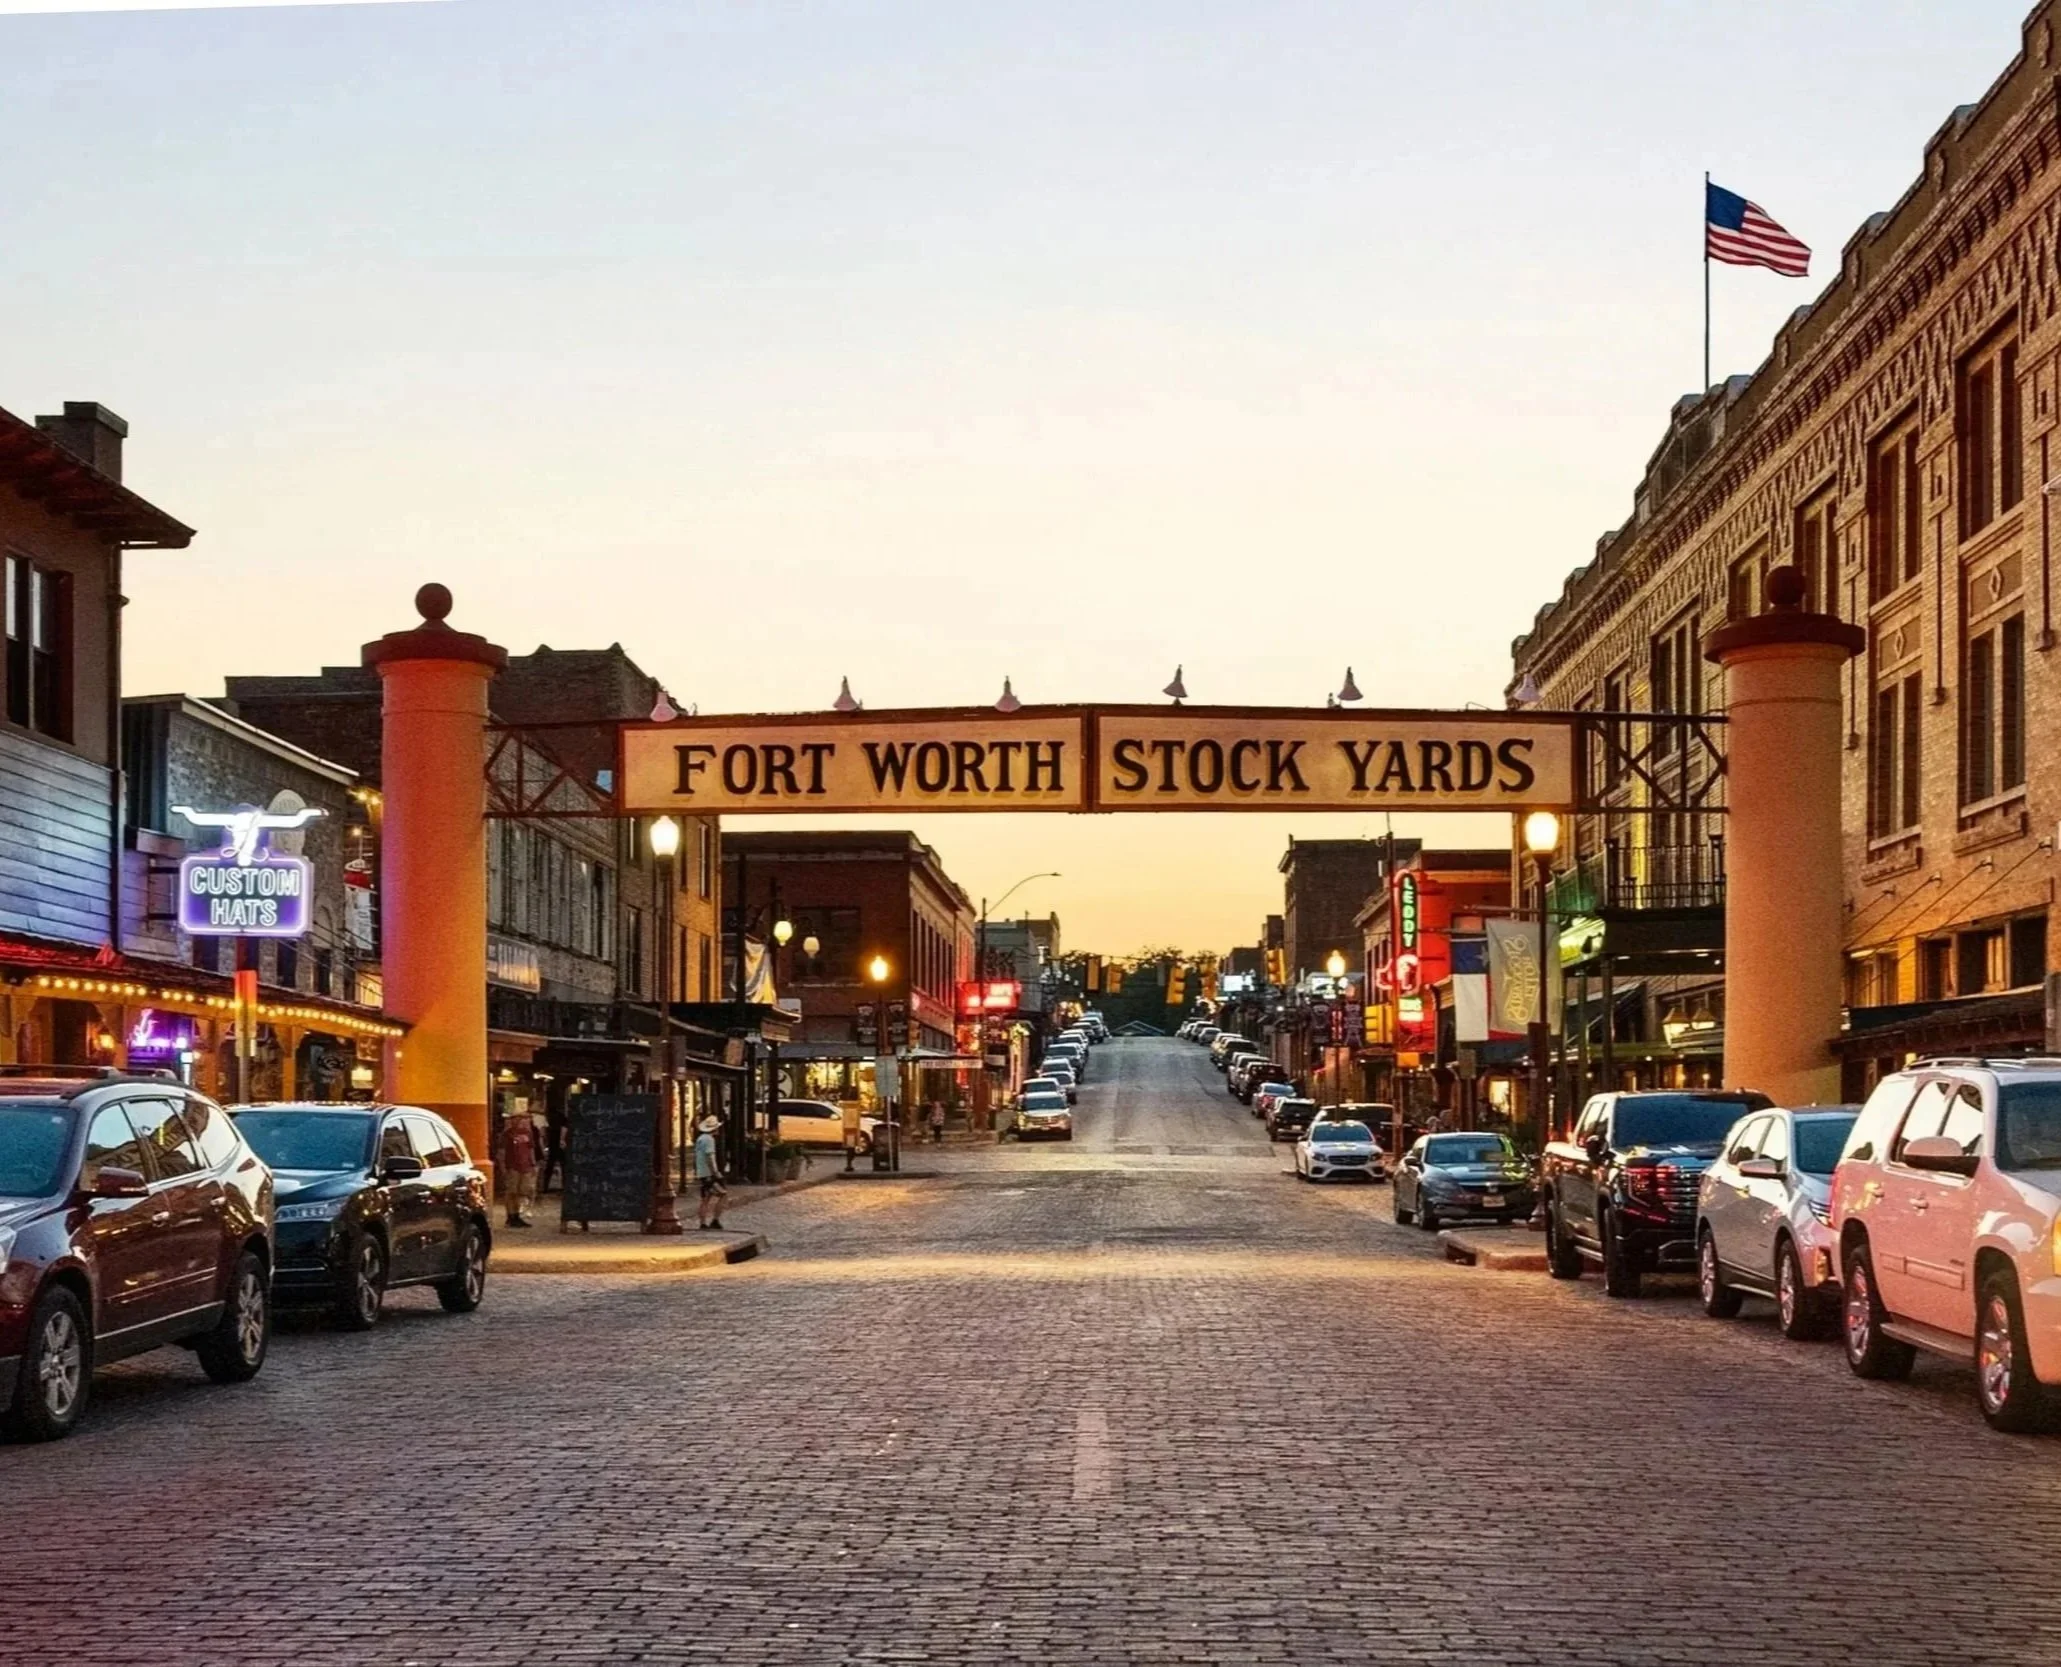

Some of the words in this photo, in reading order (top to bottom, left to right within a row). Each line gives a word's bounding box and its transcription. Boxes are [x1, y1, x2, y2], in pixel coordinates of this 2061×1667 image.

[672, 743, 835, 795] FORT
[861, 741, 1066, 793] WORTH
[1113, 739, 1310, 793] STOCK
[1337, 738, 1535, 793] YARDS
[190, 867, 300, 896] CUSTOM
[211, 899, 277, 926] HATS
[1402, 876, 1415, 947] LEDDY
